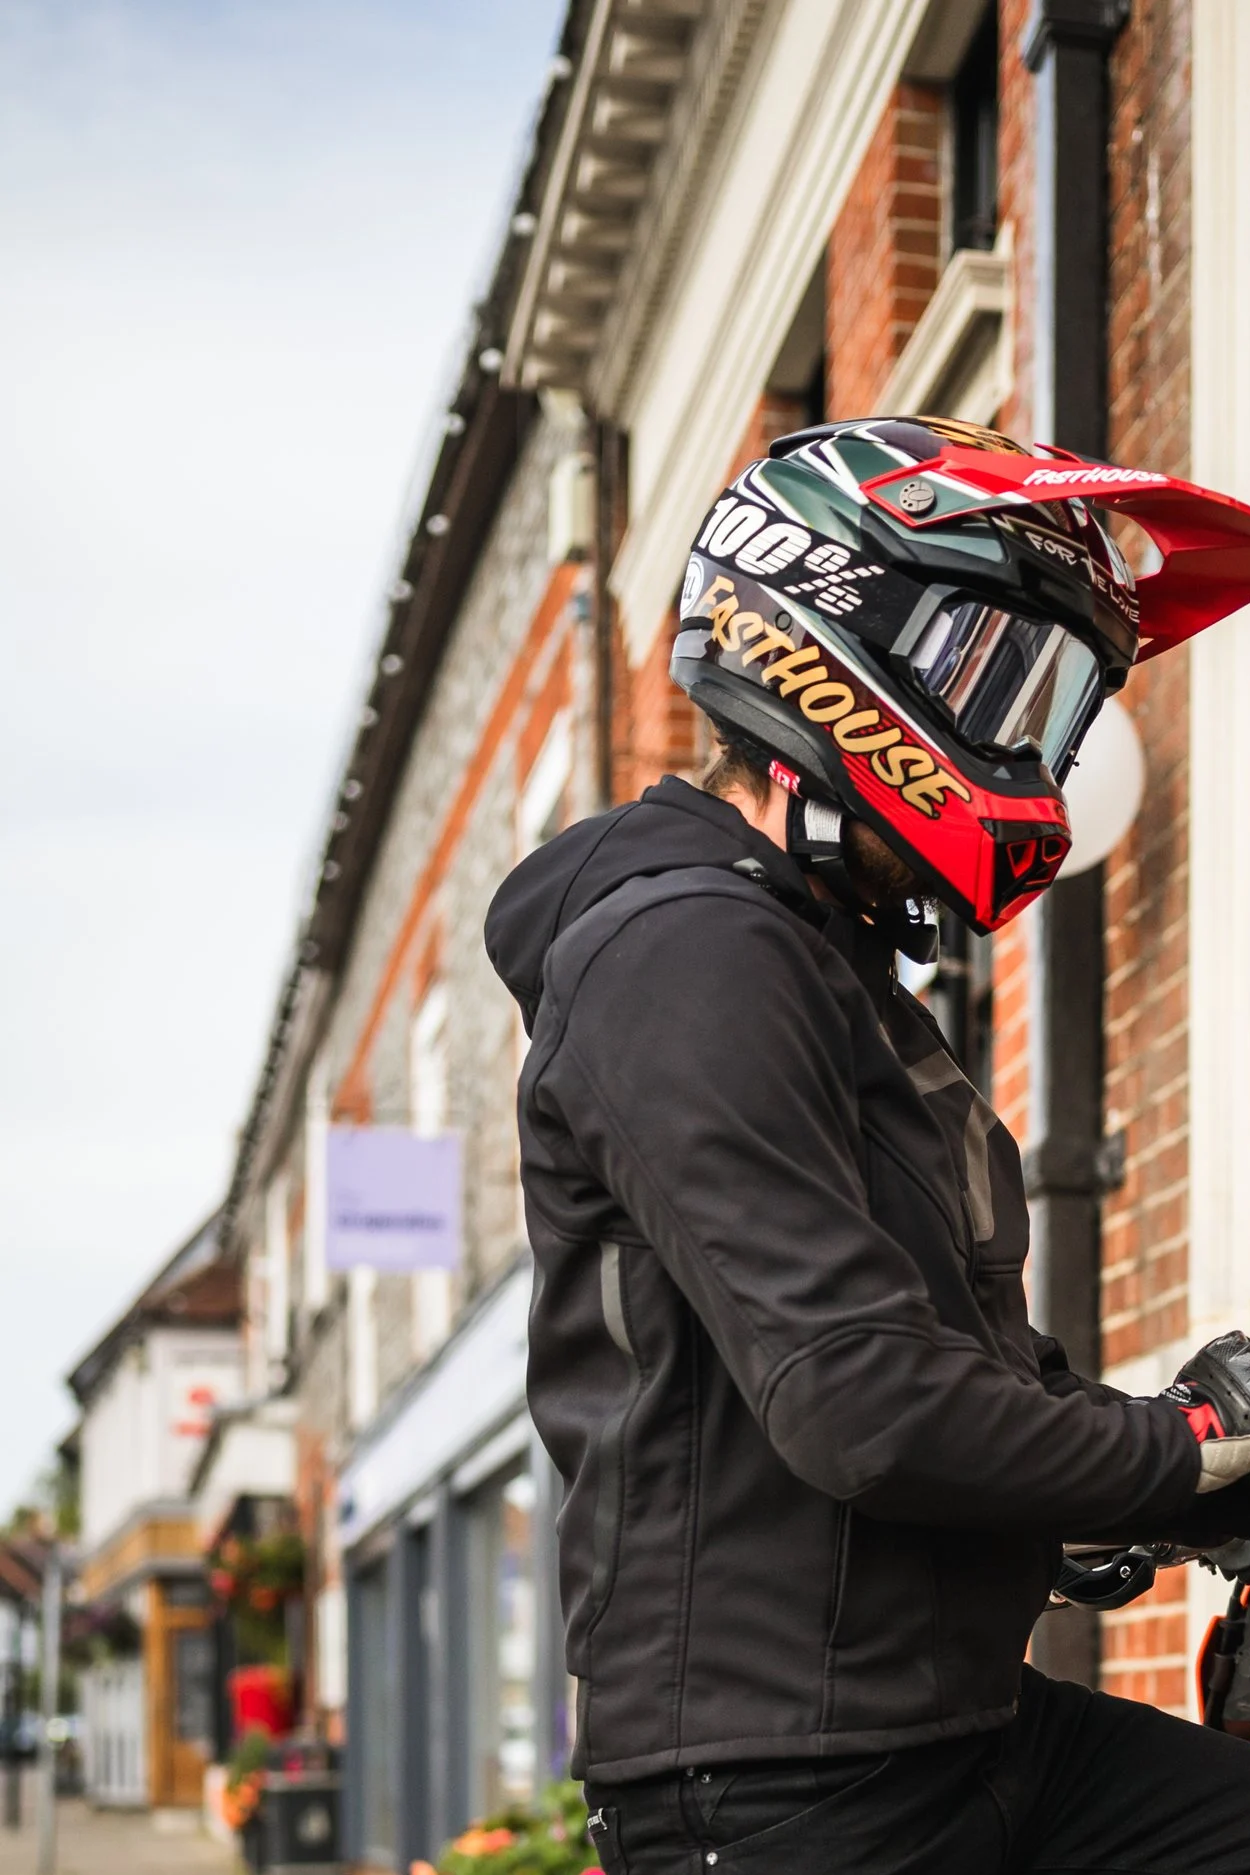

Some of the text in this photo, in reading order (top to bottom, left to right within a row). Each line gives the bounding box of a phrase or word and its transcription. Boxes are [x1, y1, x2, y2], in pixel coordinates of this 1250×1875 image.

[1023, 467, 1171, 487] FASTHOUSE
[697, 496, 886, 616] 100%
[1025, 531, 1077, 566] FOR
[694, 574, 972, 820] FASTHOUSE
